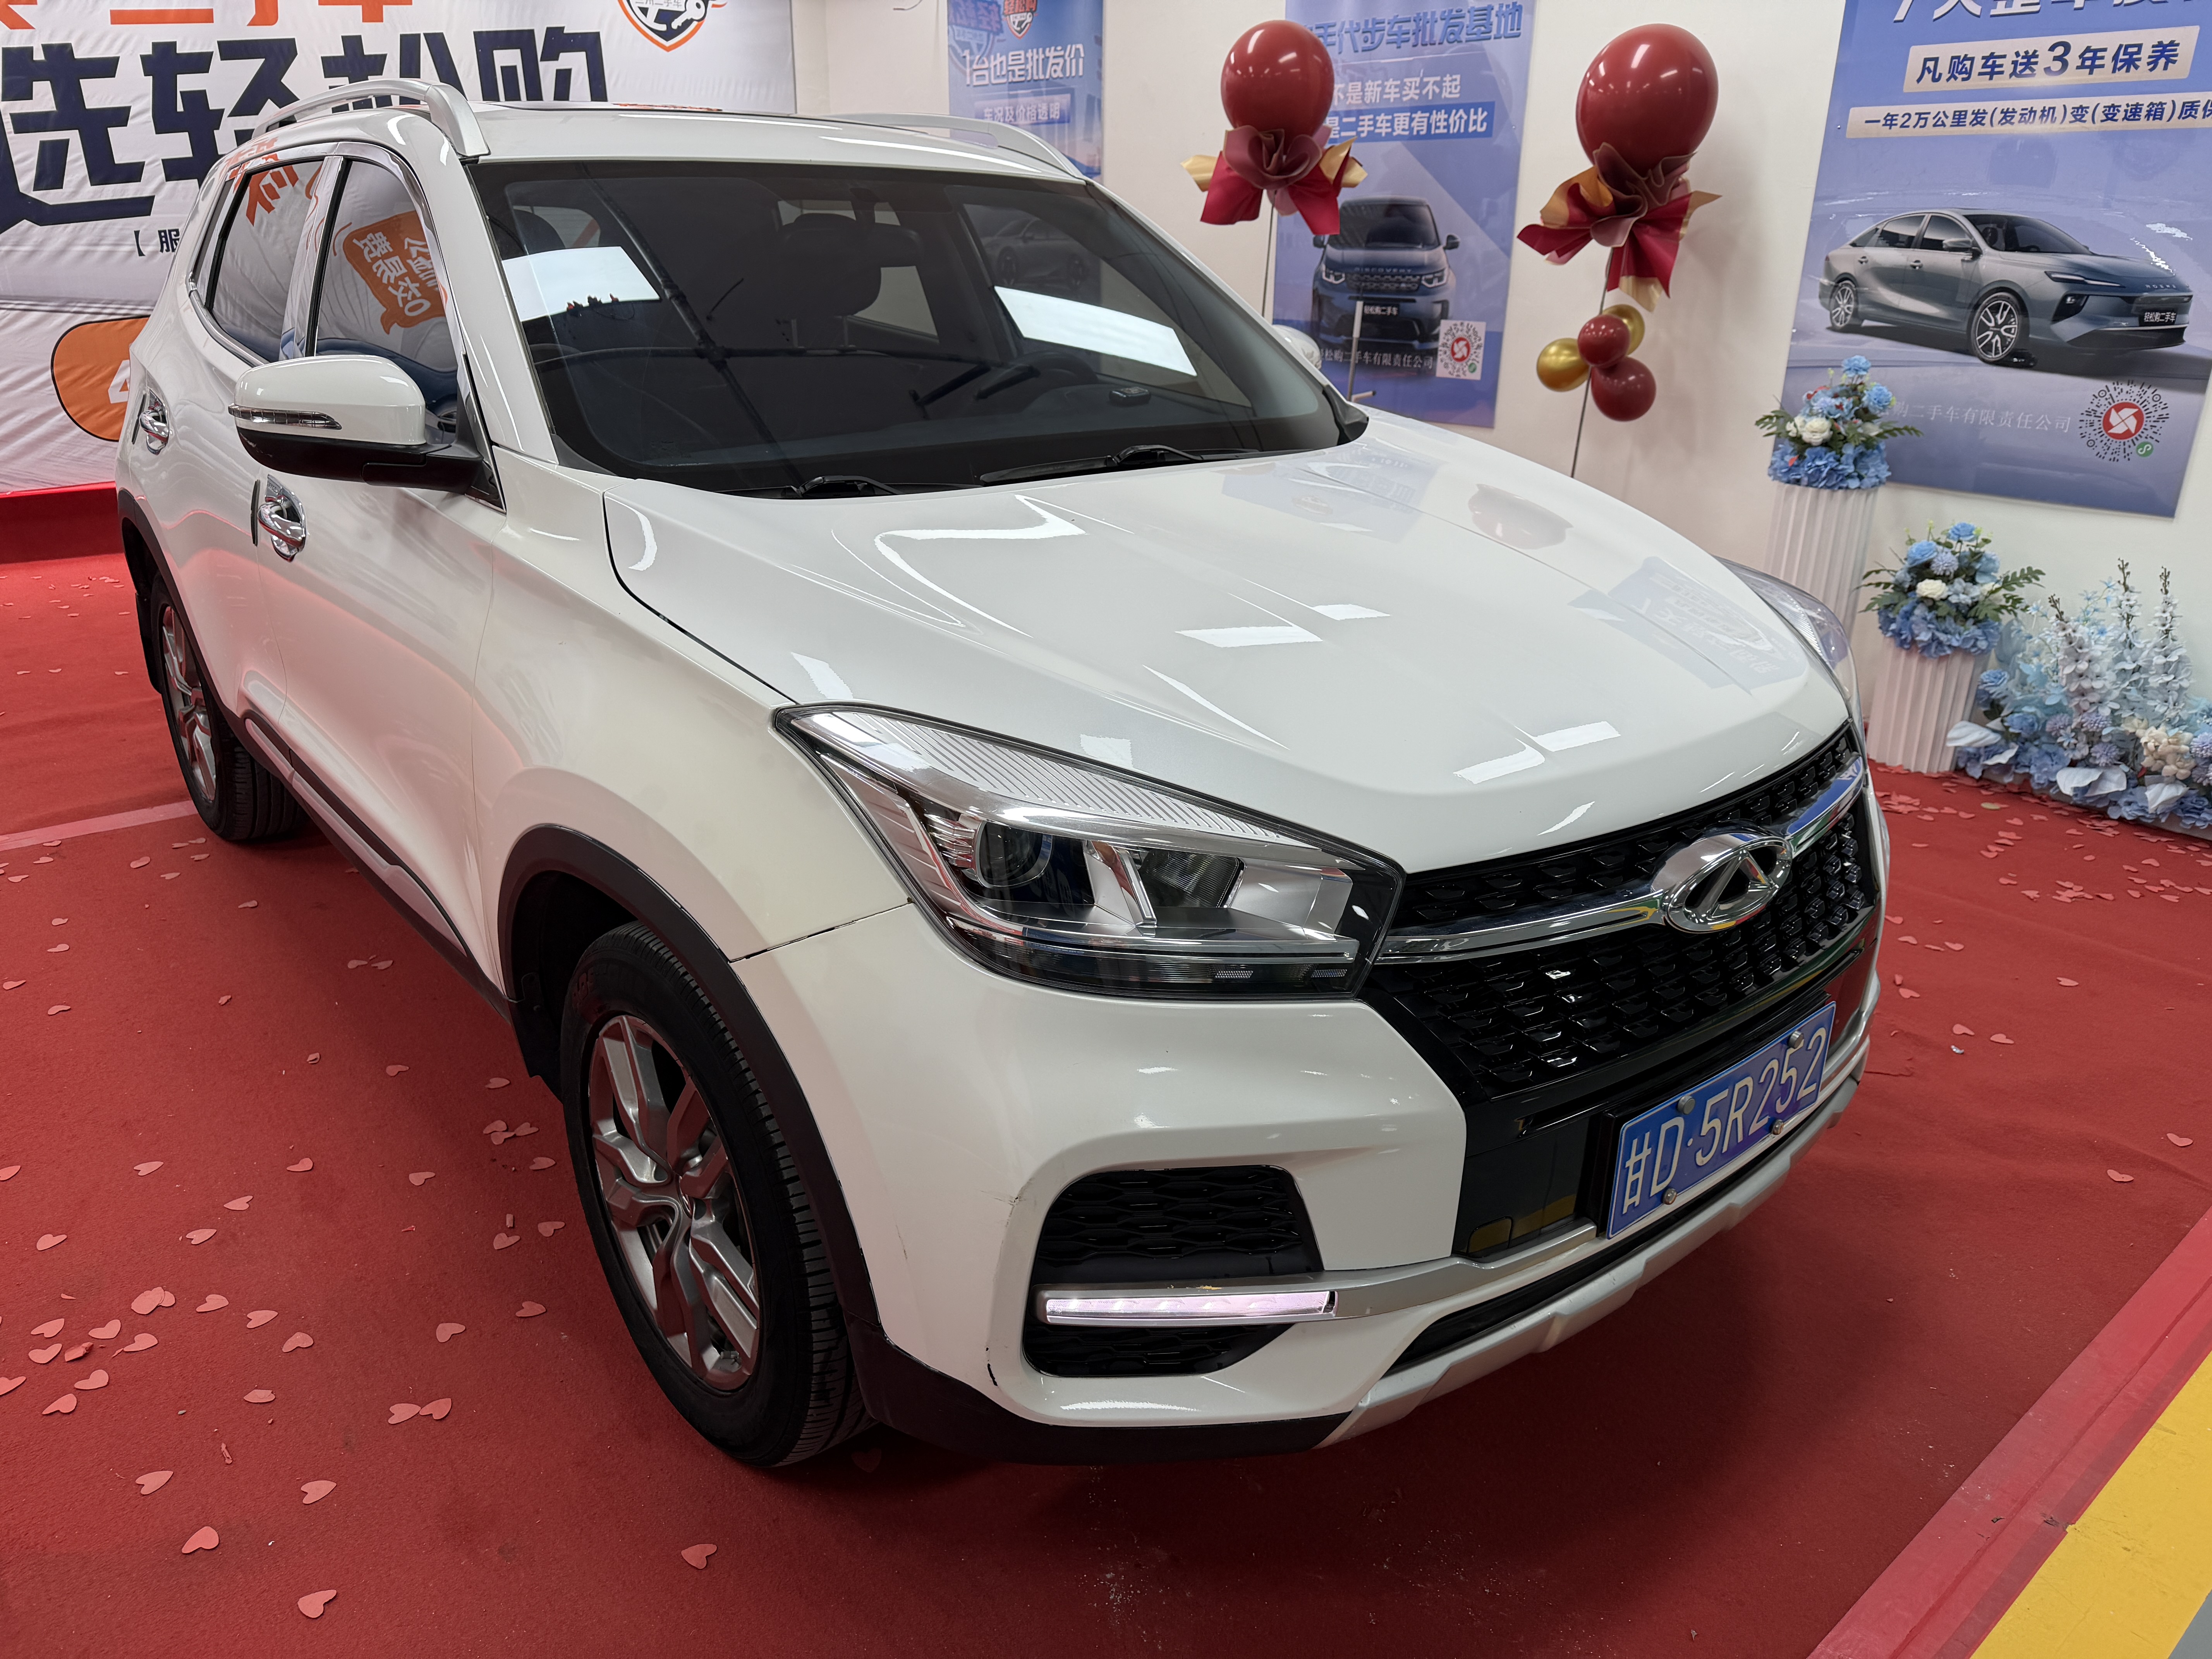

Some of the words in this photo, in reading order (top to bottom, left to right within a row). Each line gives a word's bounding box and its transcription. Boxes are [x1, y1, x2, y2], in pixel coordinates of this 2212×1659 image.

[1304, 2, 1523, 55] 手代步车批发基地
[962, 44, 1085, 87] 1台也是批发价
[1916, 40, 2181, 84] 凡购车送3年保养
[2144, 311, 2176, 323] 轻松购二手车
[1321, 348, 1433, 369] 松购二手车有限责任公司
[1877, 400, 2071, 433] 购二手车有限责任公司
[1623, 1027, 1826, 1214] 甘D·5R252
